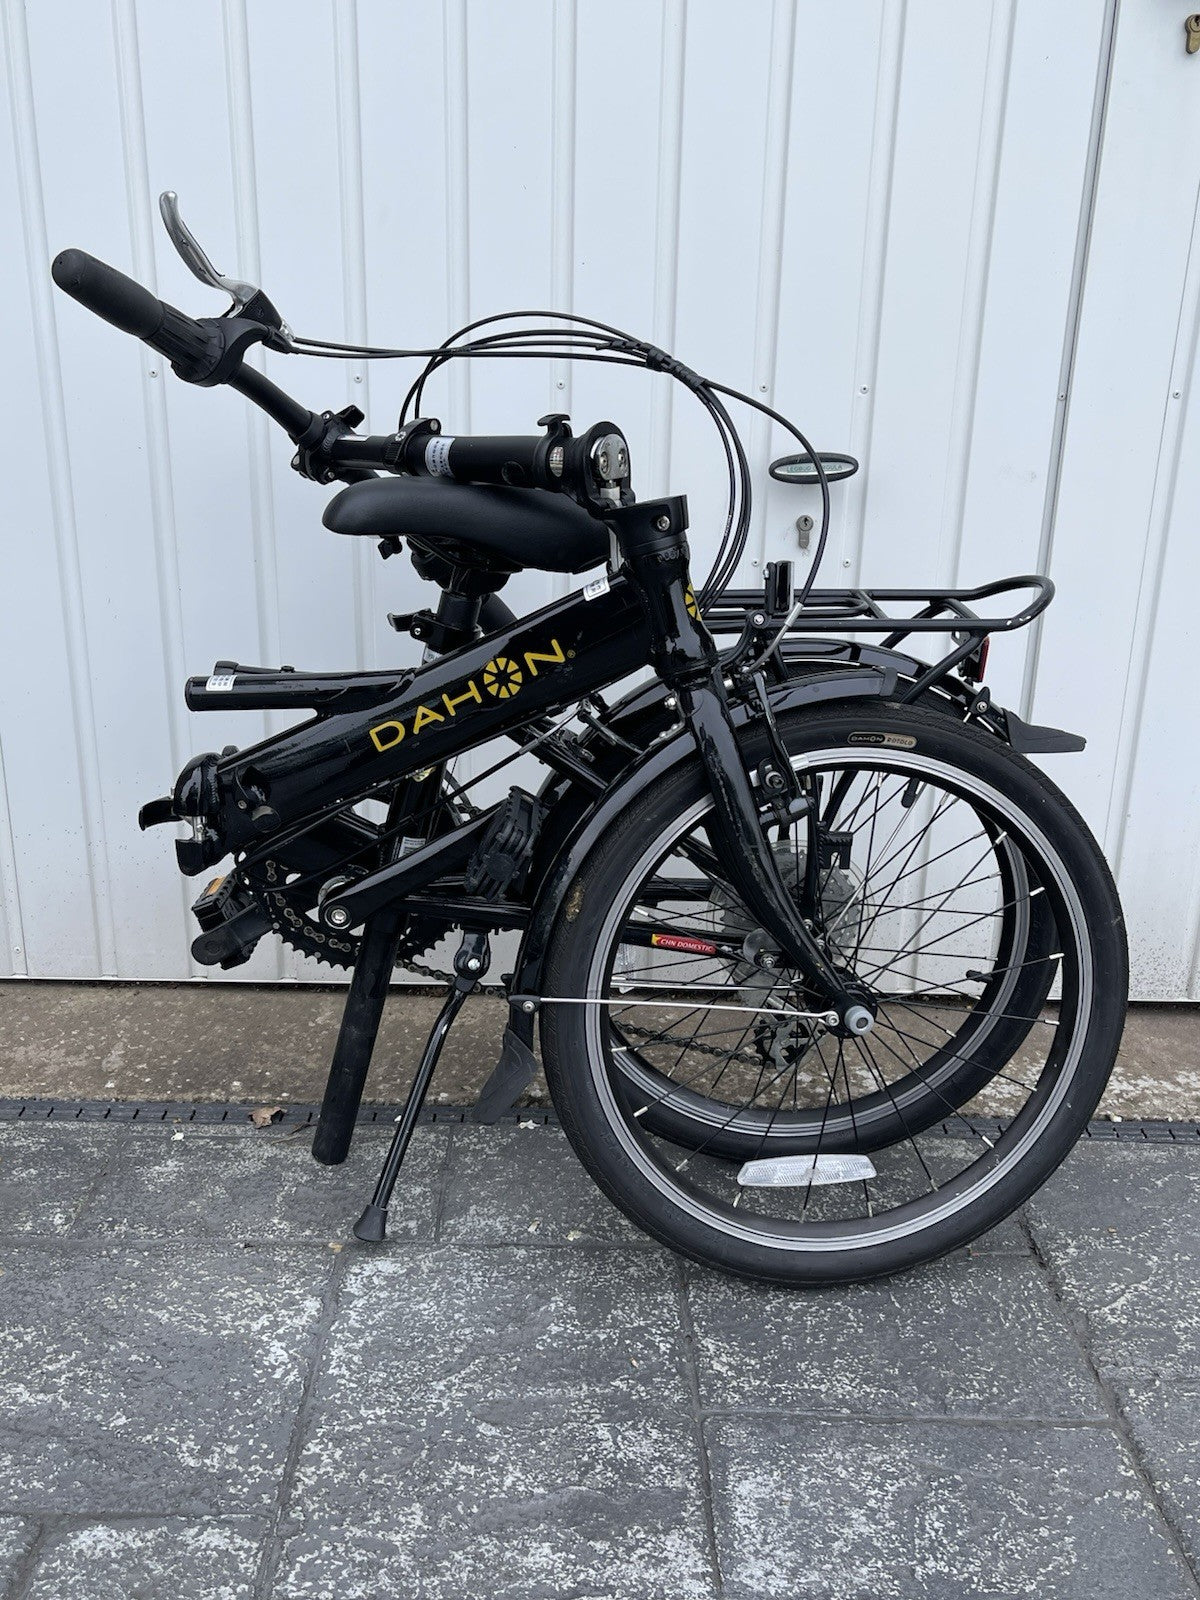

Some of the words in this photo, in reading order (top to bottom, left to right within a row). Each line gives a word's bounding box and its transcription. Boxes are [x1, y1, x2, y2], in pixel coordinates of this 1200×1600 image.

[369, 638, 566, 752] DAHON
[851, 735, 884, 743] DAHON
[660, 938, 677, 946] CHN
[677, 941, 714, 952] DOMESTIC
